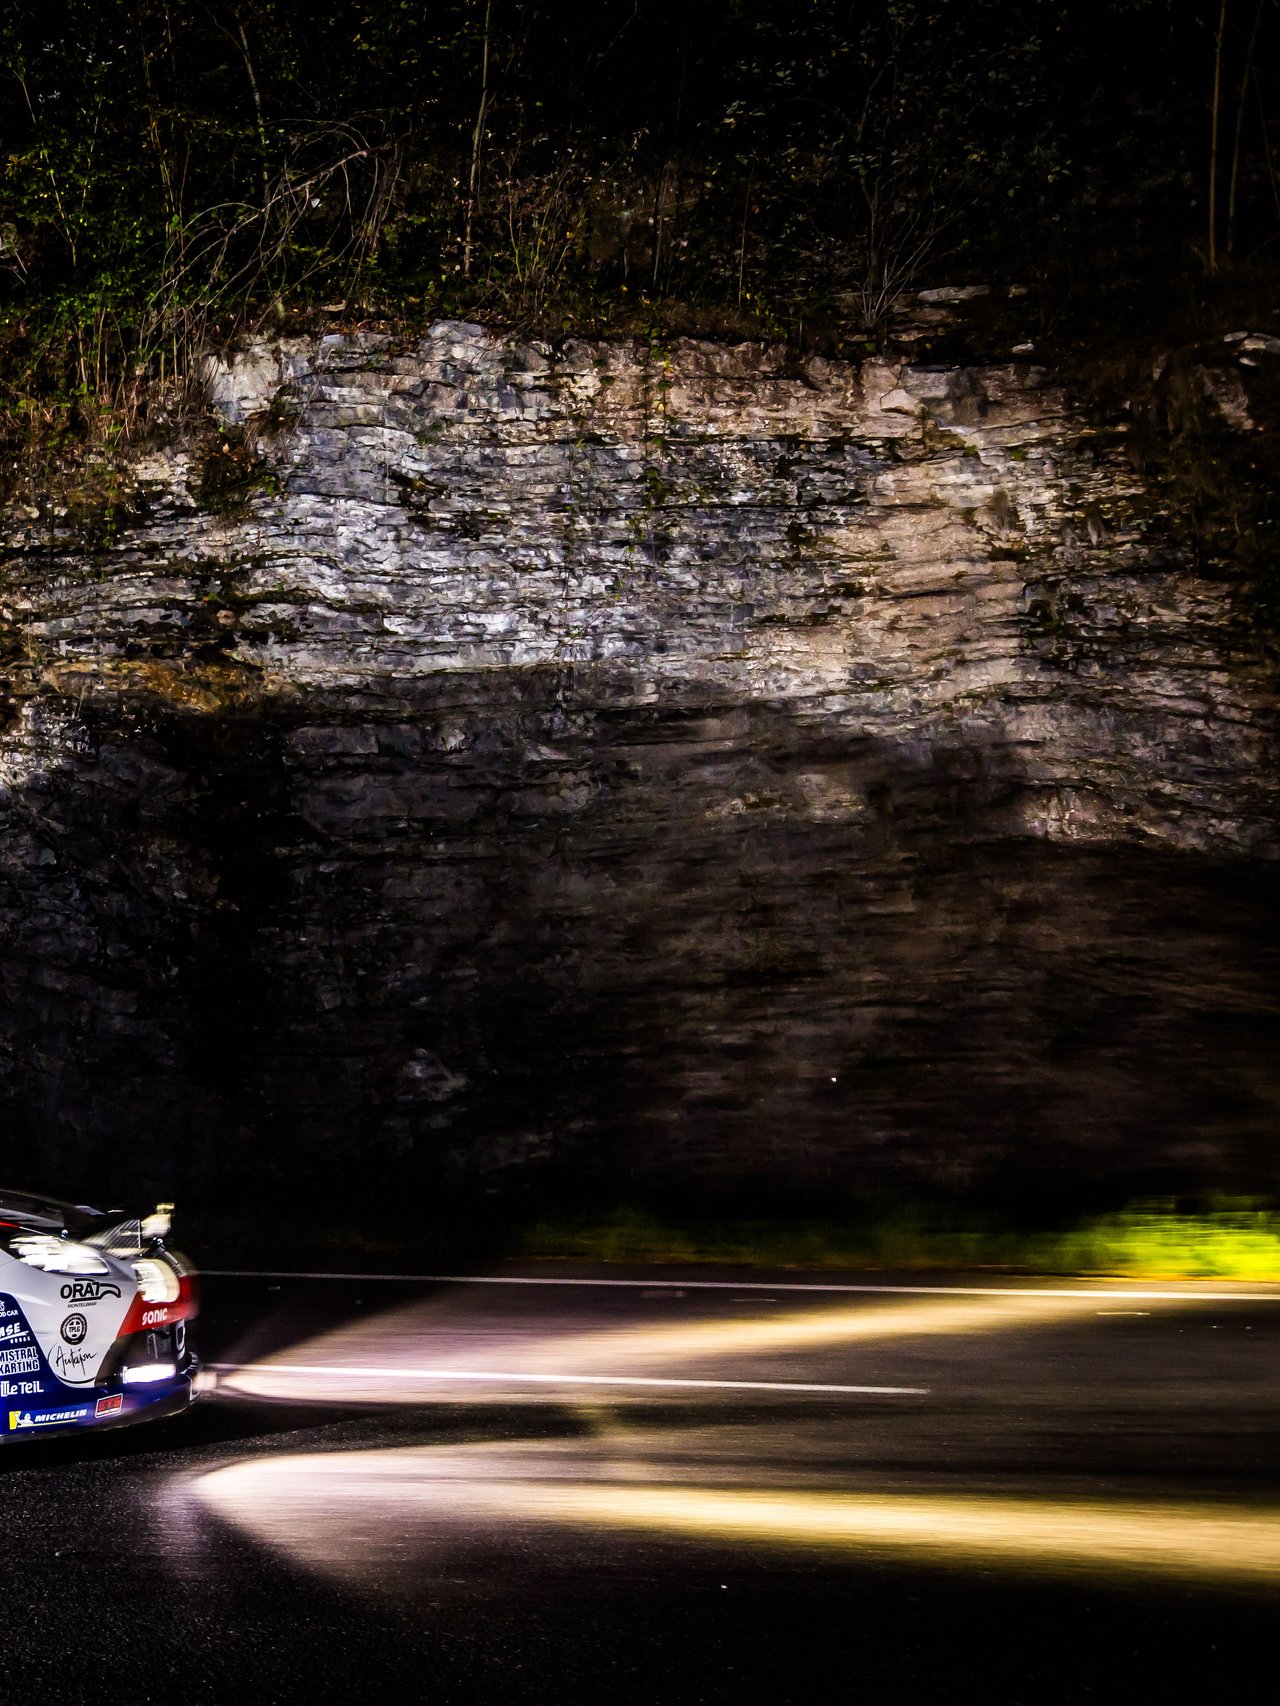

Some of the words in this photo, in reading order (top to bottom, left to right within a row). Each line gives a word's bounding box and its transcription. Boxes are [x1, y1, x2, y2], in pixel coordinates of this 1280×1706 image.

[6, 1309, 19, 1317] CAR
[142, 1307, 168, 1327] SONIC
[34, 1408, 88, 1423] MICHELIN
